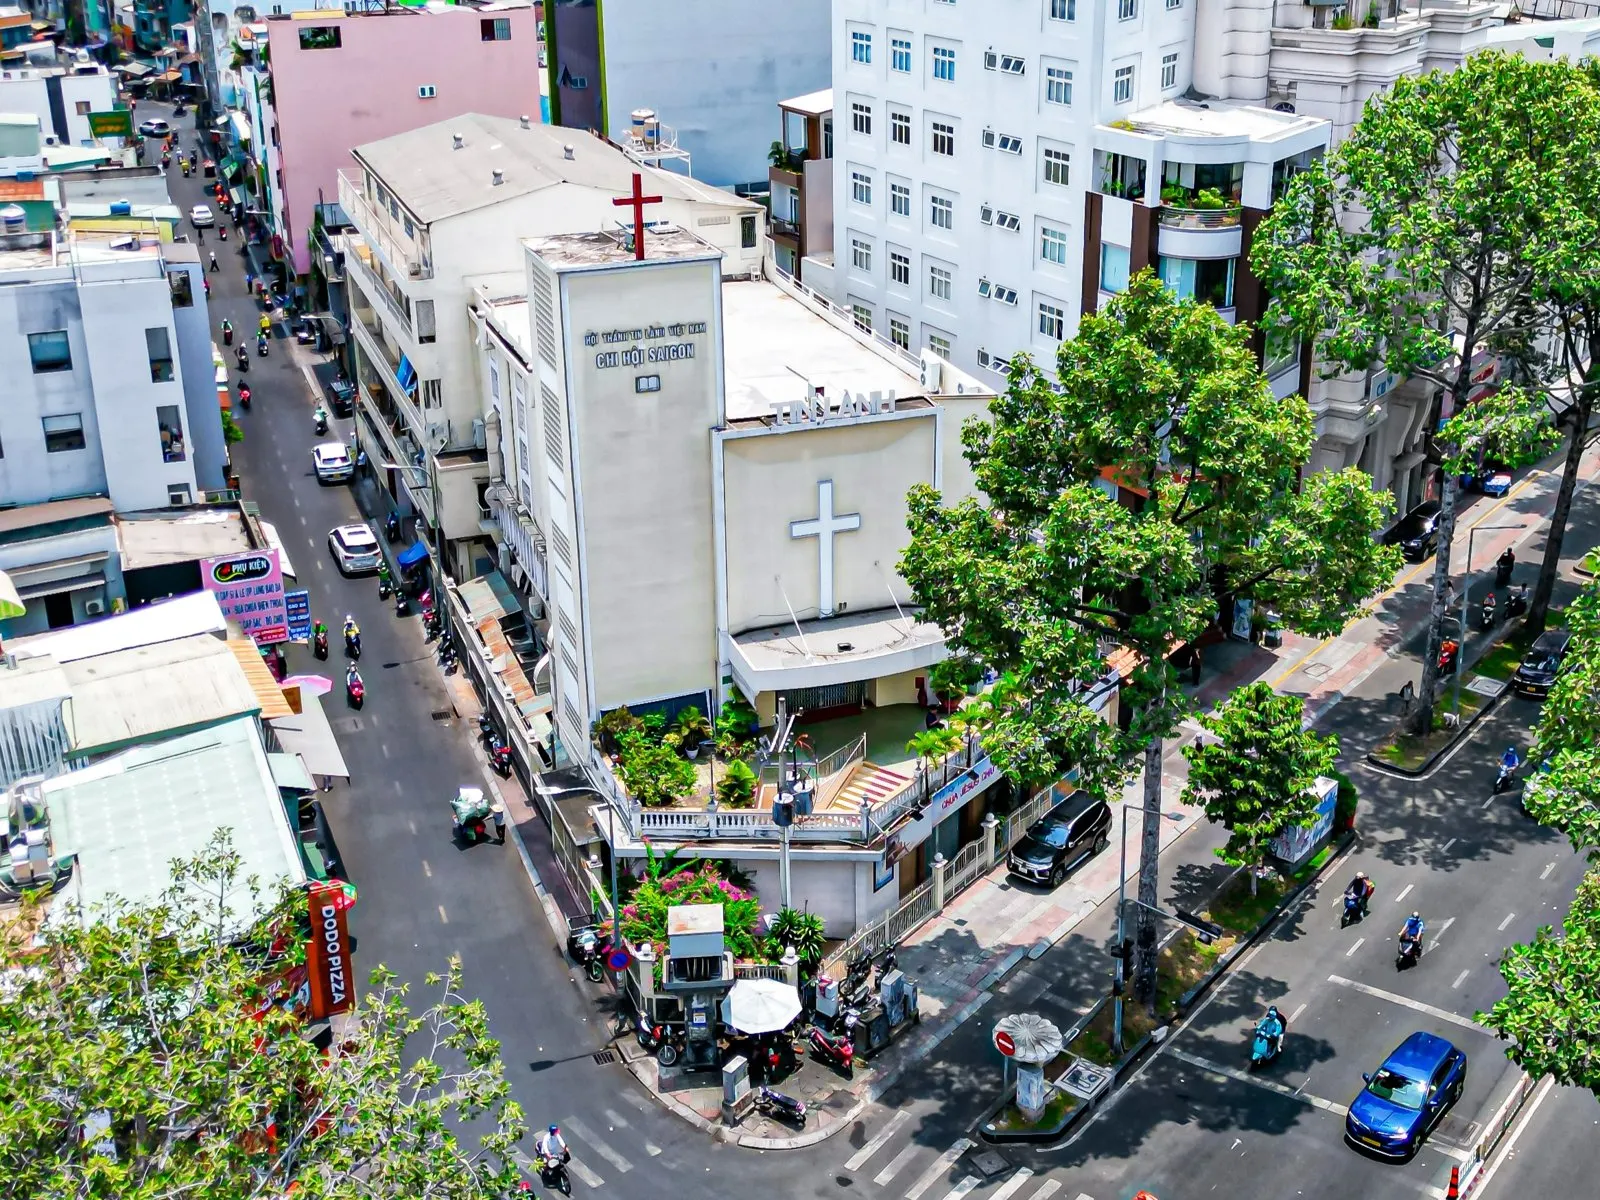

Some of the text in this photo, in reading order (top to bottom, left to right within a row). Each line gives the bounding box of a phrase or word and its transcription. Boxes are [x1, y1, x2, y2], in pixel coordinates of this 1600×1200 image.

[630, 329, 642, 341] TIN
[688, 322, 707, 335] NAM
[596, 351, 619, 369] CHI
[648, 342, 695, 362] SAIGON
[322, 905, 346, 1005] DODO PIZZA
